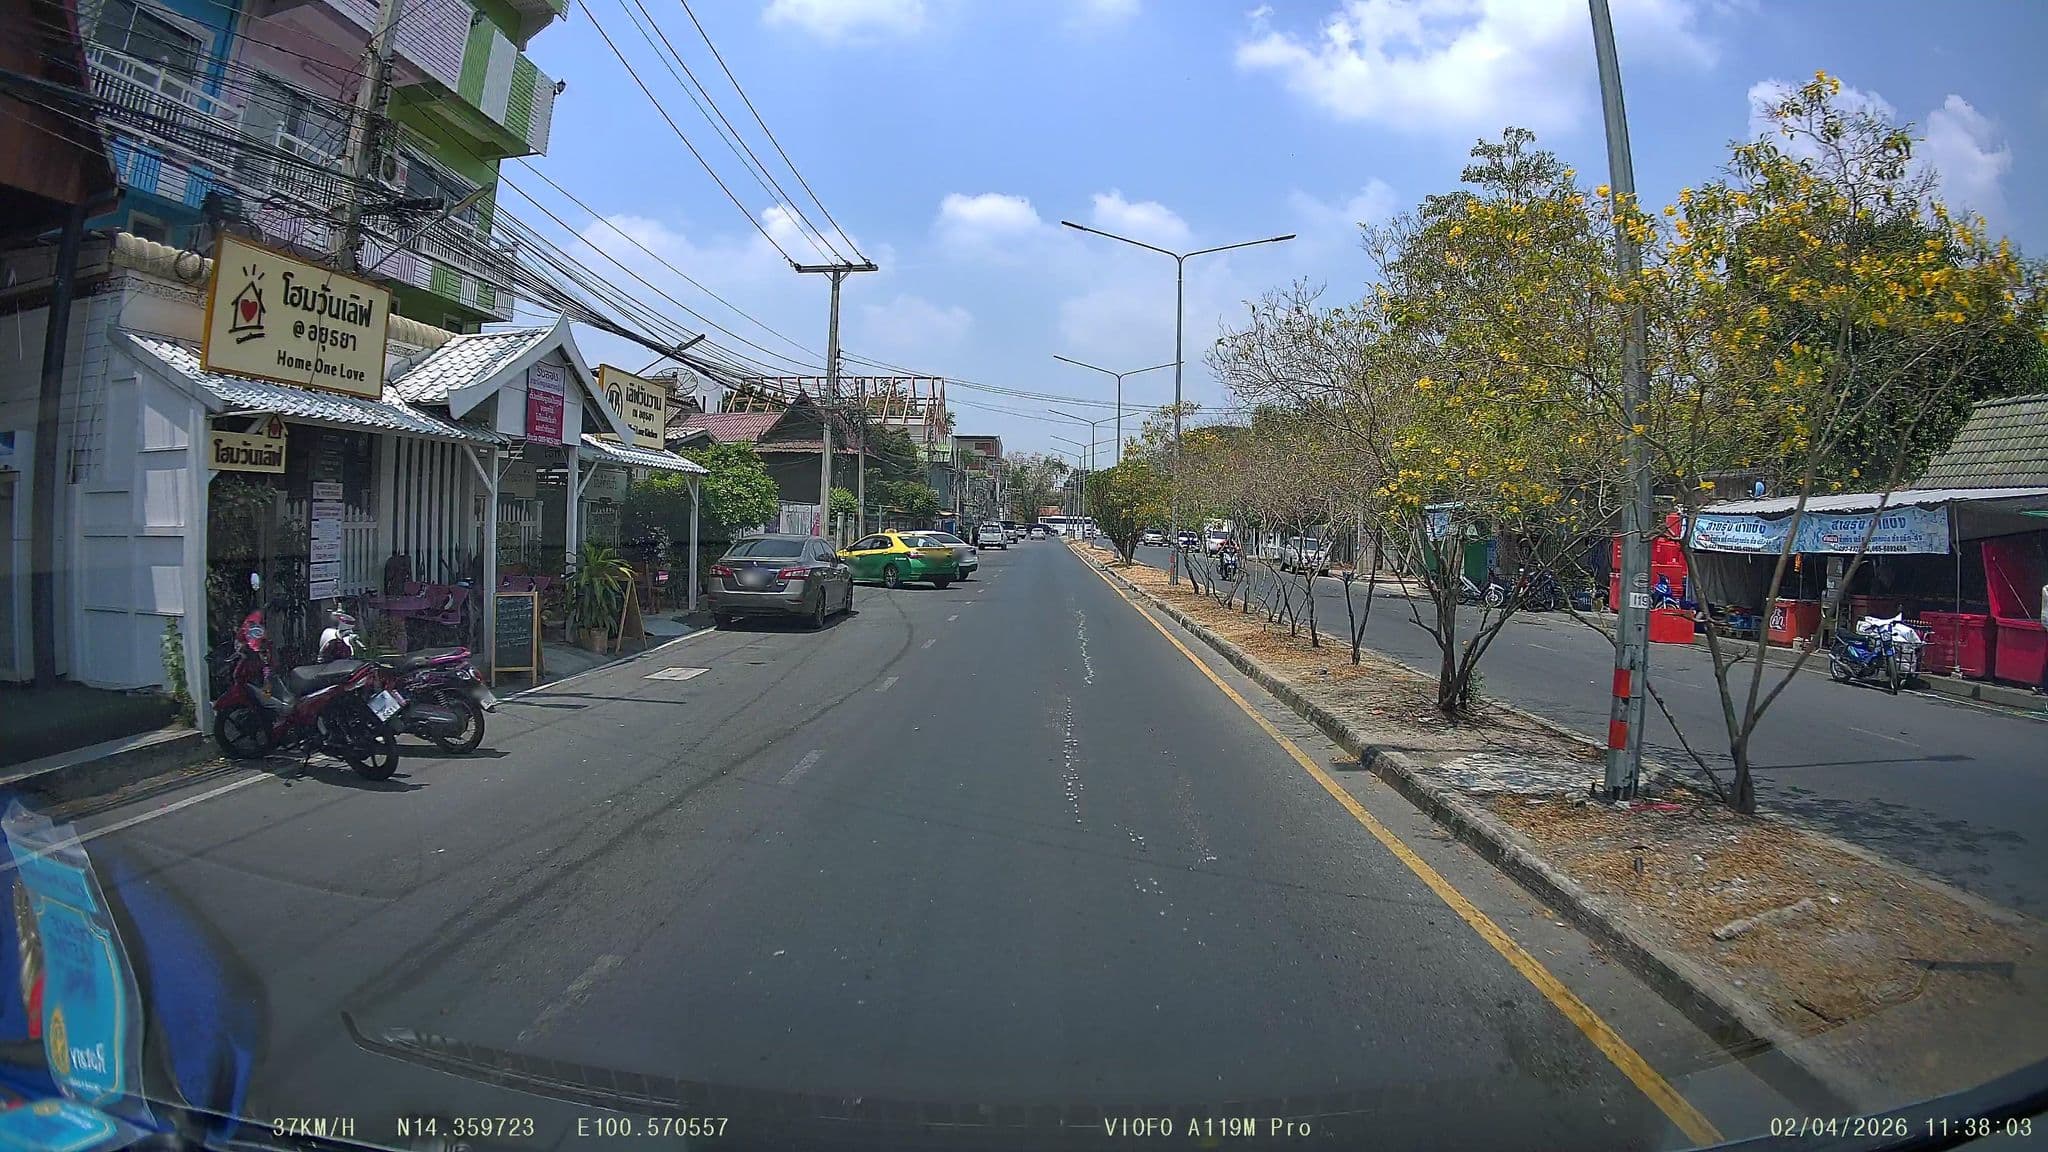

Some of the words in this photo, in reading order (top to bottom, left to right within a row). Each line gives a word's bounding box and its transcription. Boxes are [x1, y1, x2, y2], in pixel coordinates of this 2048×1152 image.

[282, 271, 374, 328] โฮมวันเลิฟ
[292, 320, 305, 338] @
[308, 325, 357, 352] อยุธยา
[277, 350, 312, 371] Home
[315, 357, 337, 376] One
[340, 363, 366, 382] Love
[213, 439, 283, 467] โฮมวันเลิฟ
